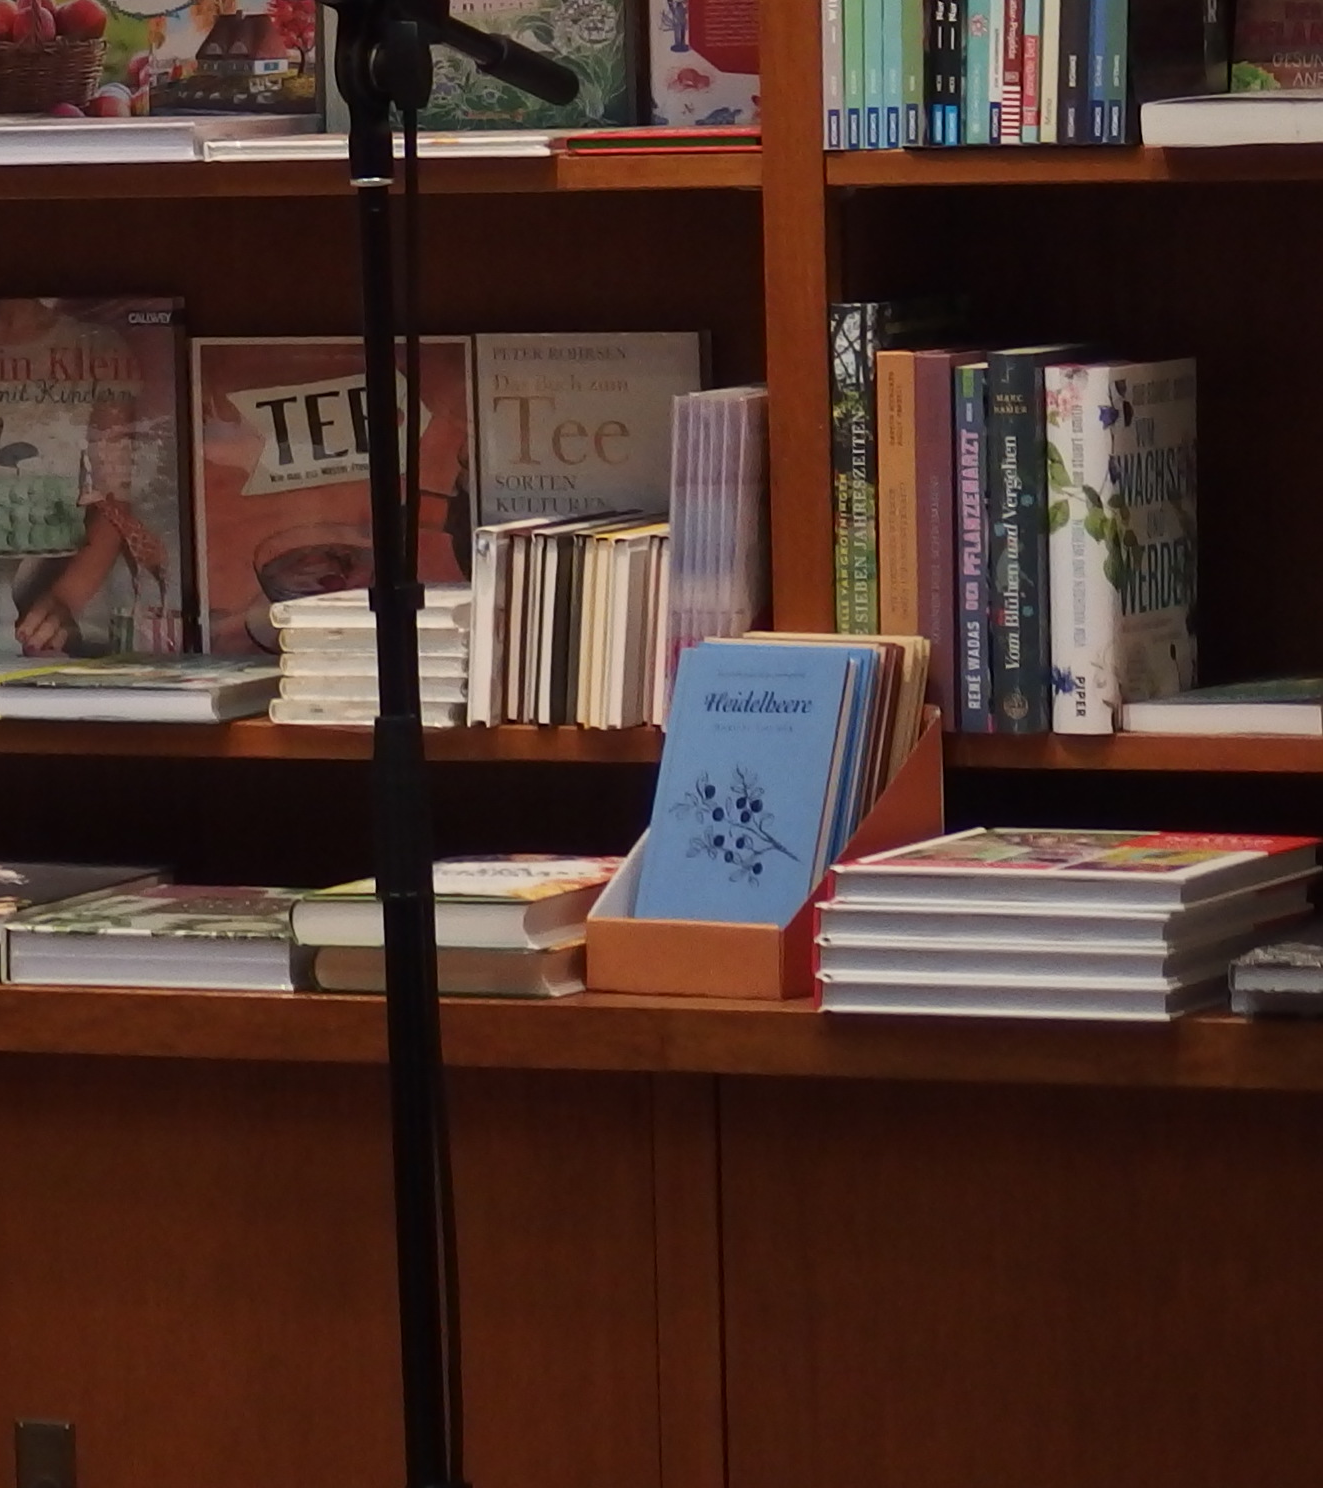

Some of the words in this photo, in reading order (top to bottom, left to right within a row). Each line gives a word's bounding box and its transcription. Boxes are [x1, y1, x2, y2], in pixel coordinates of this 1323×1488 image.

[129, 313, 171, 323] CALLWEY
[493, 396, 631, 466] Tee
[495, 475, 577, 491] SORTEN
[1001, 435, 1022, 520] Vergehen
[961, 429, 981, 576] PFLANZENARZT
[1006, 523, 1020, 561] und
[965, 581, 978, 610] DER
[1005, 567, 1020, 628] Blühen
[966, 621, 979, 669] WADAS
[1006, 636, 1019, 671] Vom
[705, 690, 811, 714] Heidelbeere
[965, 673, 981, 710] RENÉ
[1076, 677, 1085, 717] PIPER
